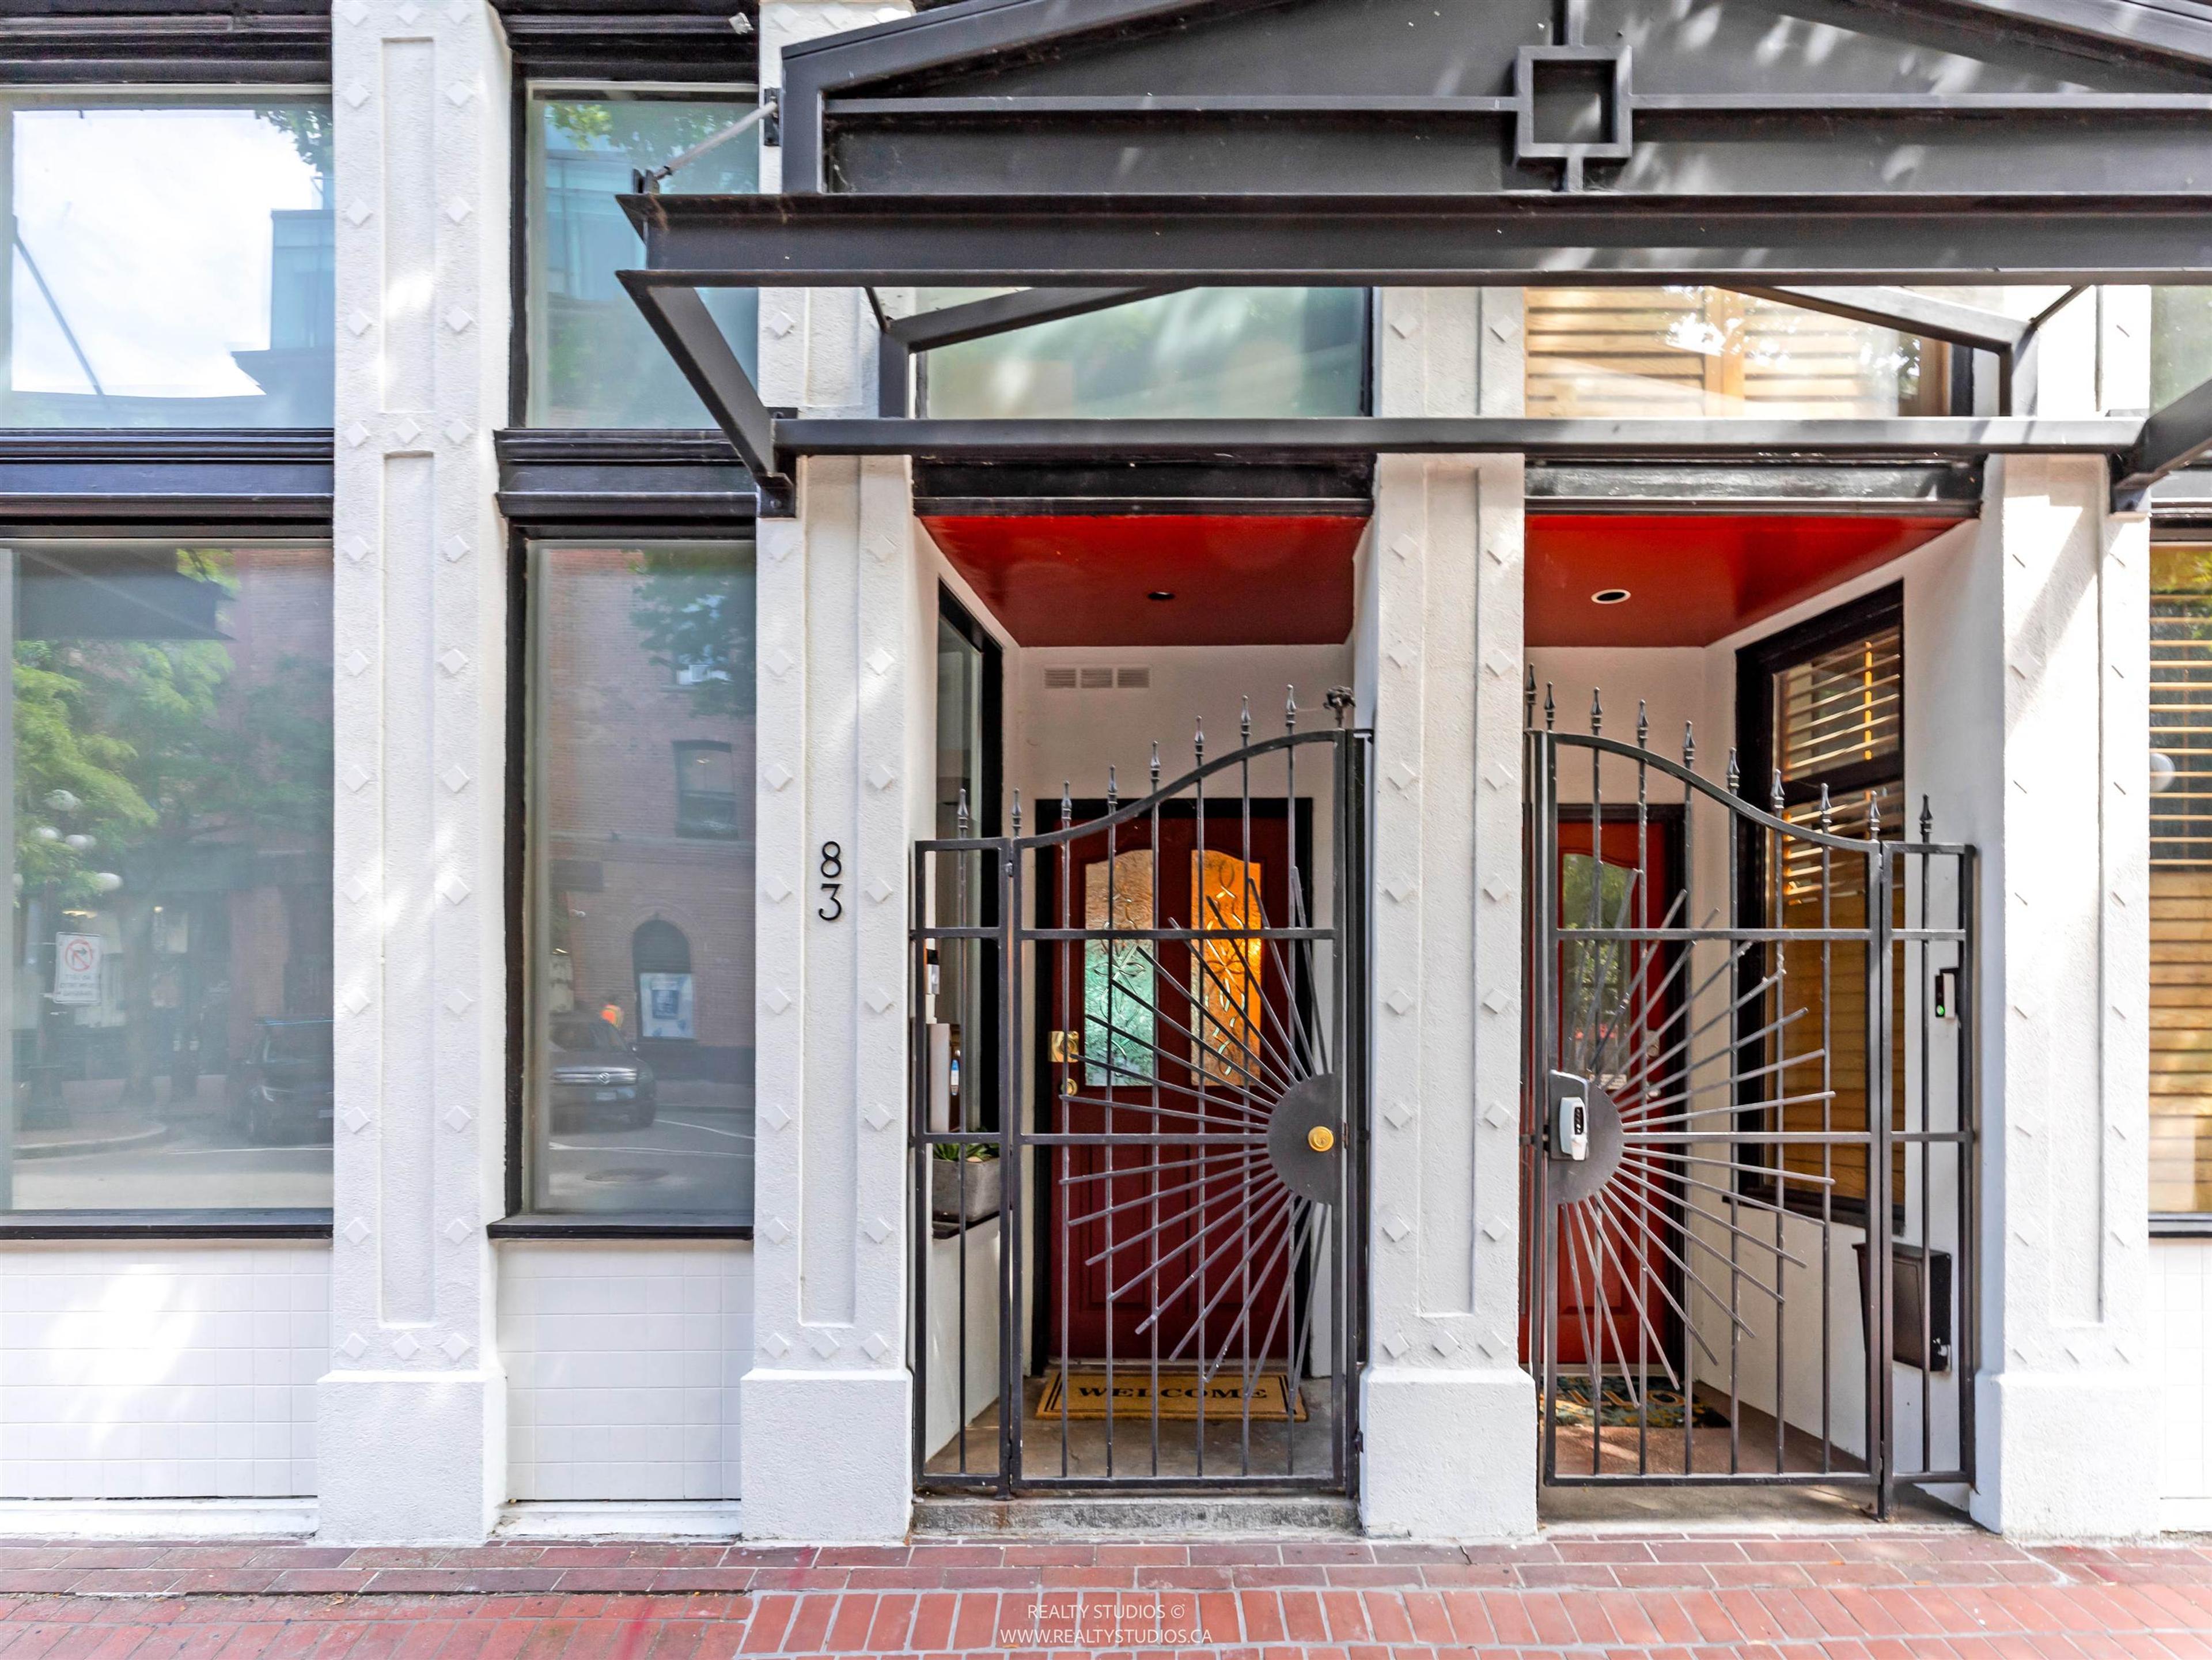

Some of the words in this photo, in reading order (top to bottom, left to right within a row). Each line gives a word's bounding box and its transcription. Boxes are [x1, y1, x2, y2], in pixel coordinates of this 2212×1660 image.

[819, 841, 842, 921] 83
[1079, 1387, 1267, 1398] WELCOME
[1555, 1389, 1686, 1407] LLO
